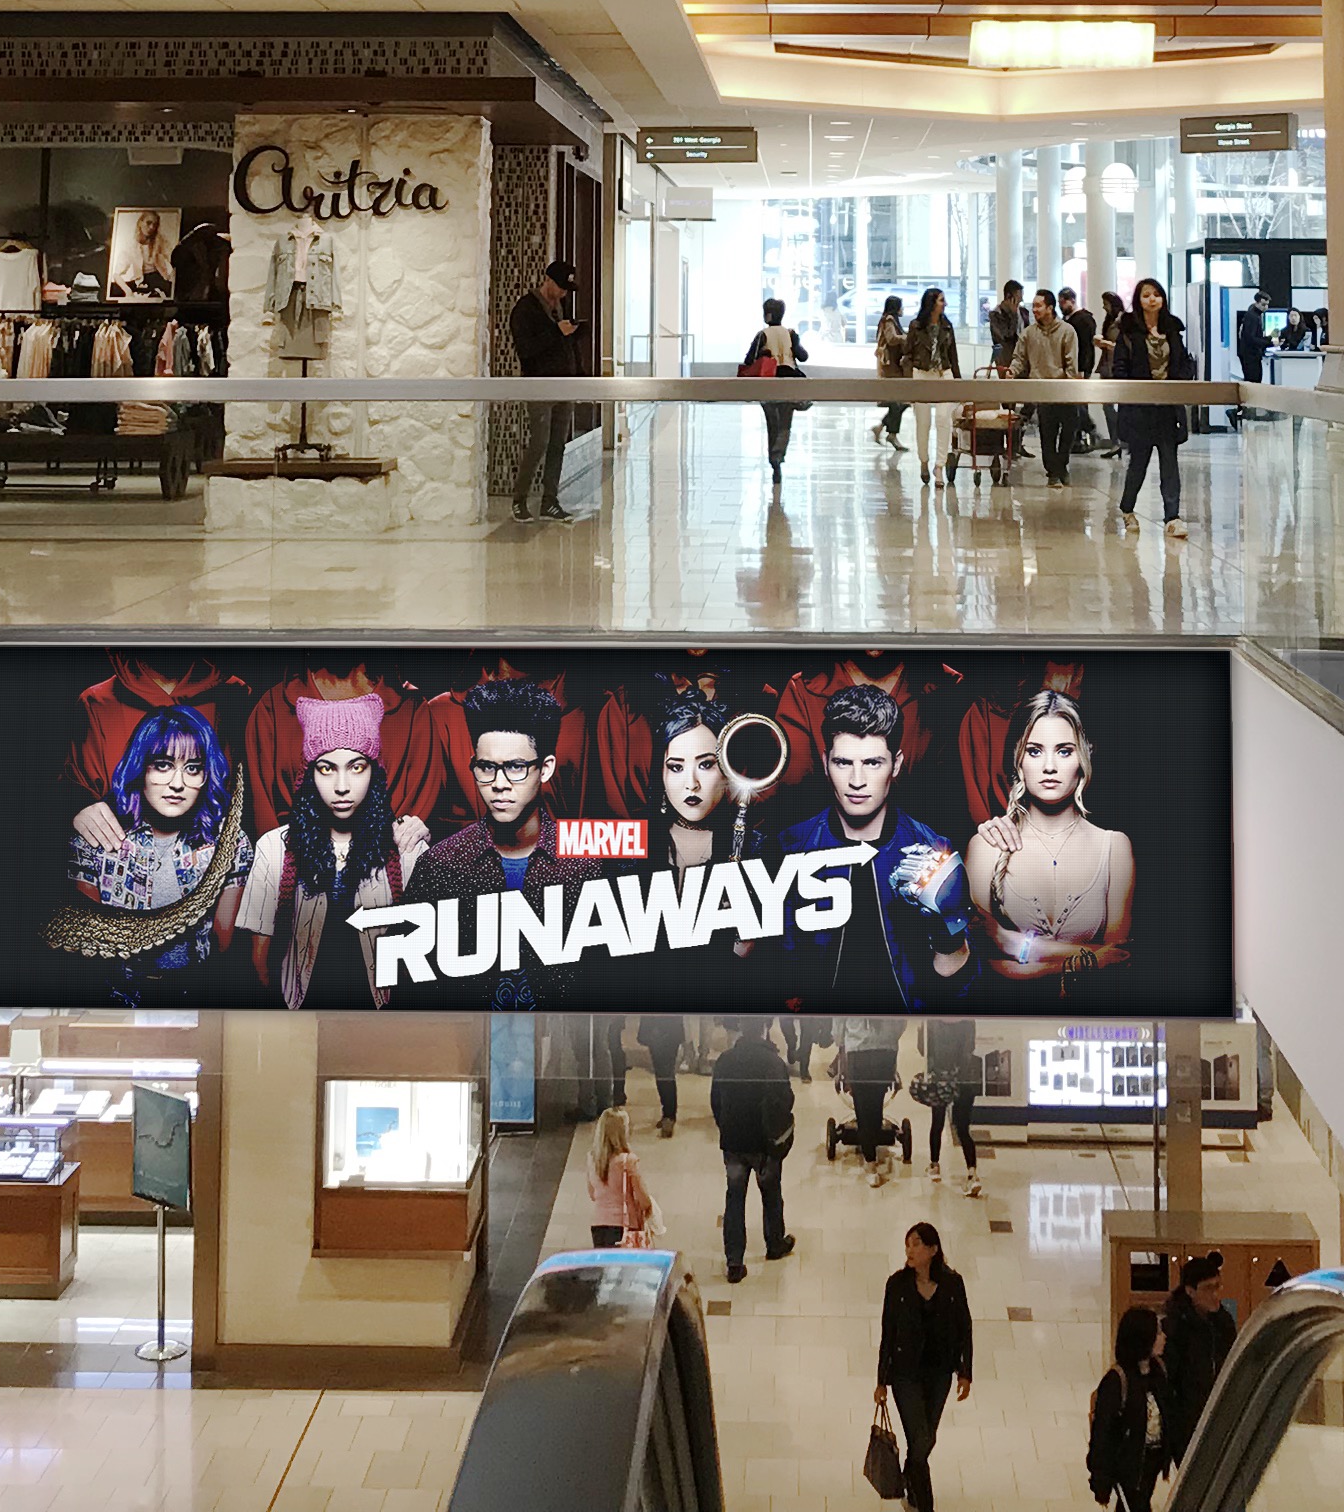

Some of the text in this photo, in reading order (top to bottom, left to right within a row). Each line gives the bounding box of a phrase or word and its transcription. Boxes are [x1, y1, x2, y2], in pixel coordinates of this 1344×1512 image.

[233, 144, 449, 221] Aritzia
[558, 821, 645, 857] MARVEL
[346, 841, 879, 988] RUNAWAYS
